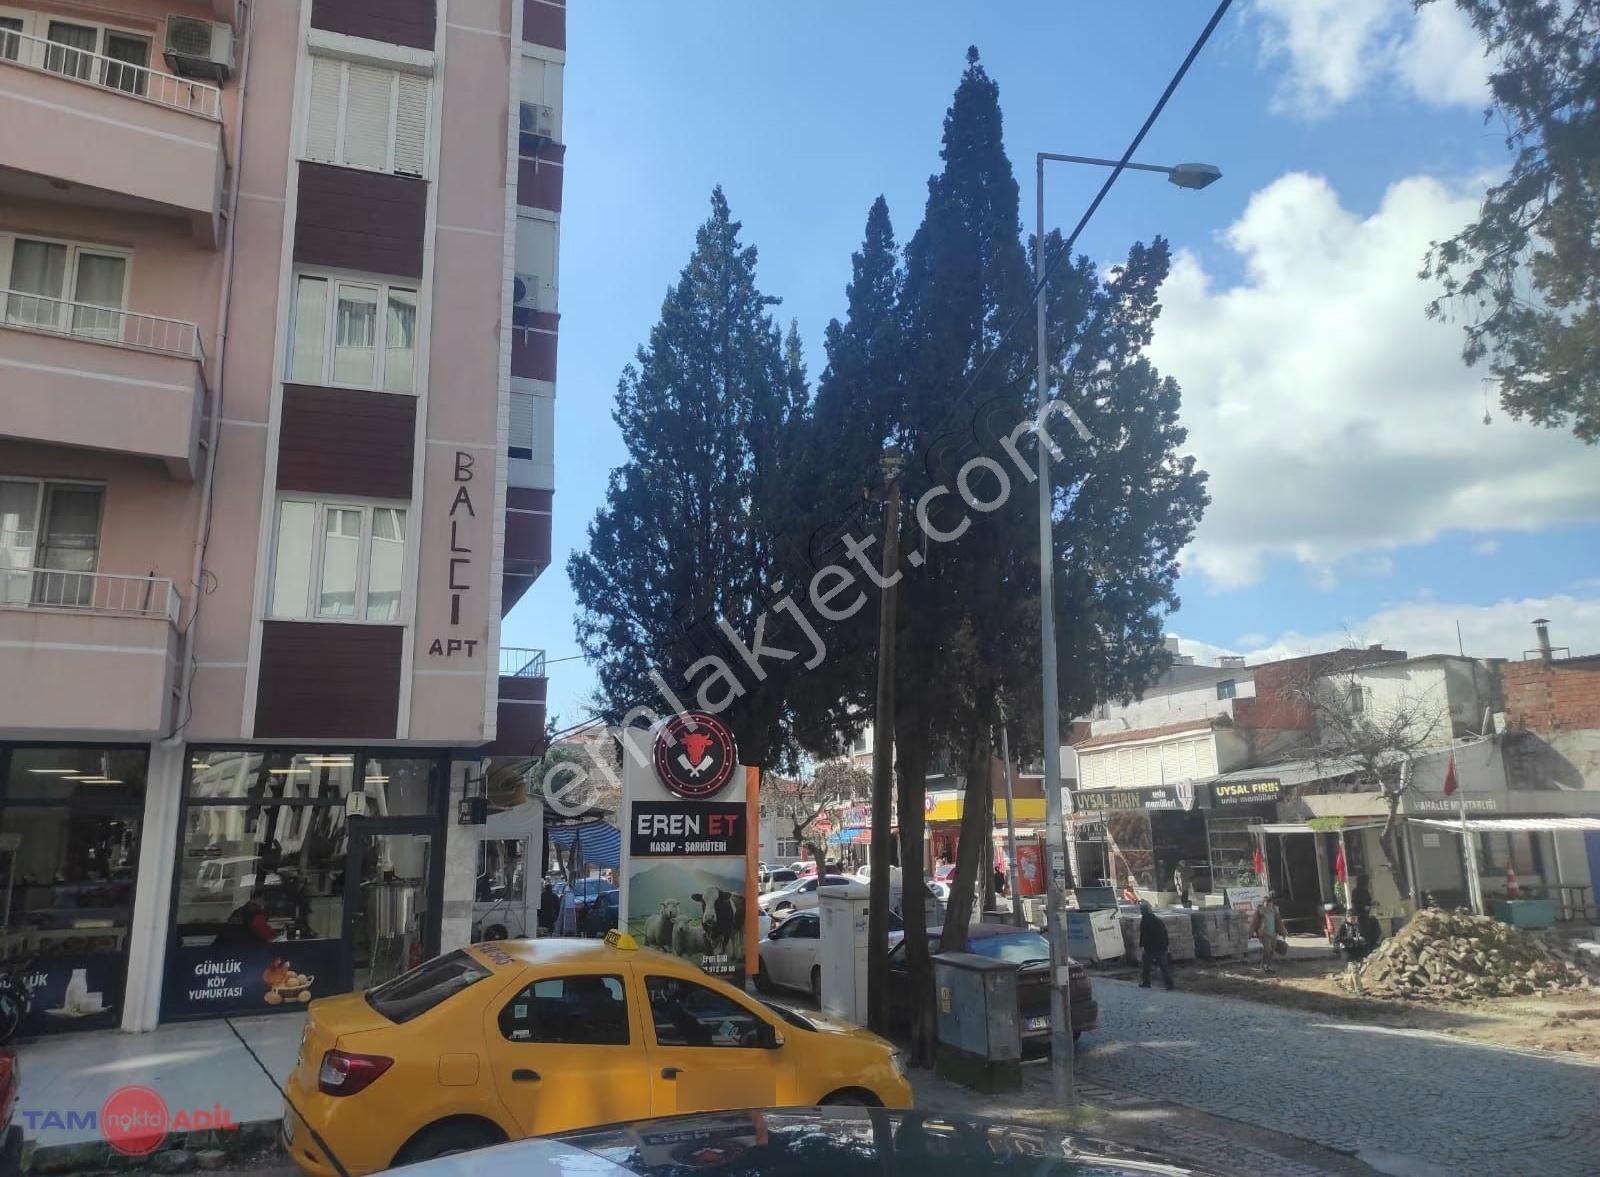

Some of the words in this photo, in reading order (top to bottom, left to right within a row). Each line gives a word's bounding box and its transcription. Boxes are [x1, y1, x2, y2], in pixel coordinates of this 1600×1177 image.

[449, 451, 475, 625] BALCI
[429, 638, 478, 657] APT
[1216, 784, 1250, 796] UYSAL
[1077, 793, 1109, 809] UYSAL
[1111, 791, 1140, 809] FIRIN
[637, 814, 700, 837] EREN
[708, 814, 738, 836] ET
[650, 841, 676, 852] KASAP
[685, 840, 727, 854] ŞARKÜTERİ
[195, 959, 242, 975] GÜNLÜK
[207, 976, 226, 987] KÖY
[189, 987, 243, 1000] YUMURTASI
